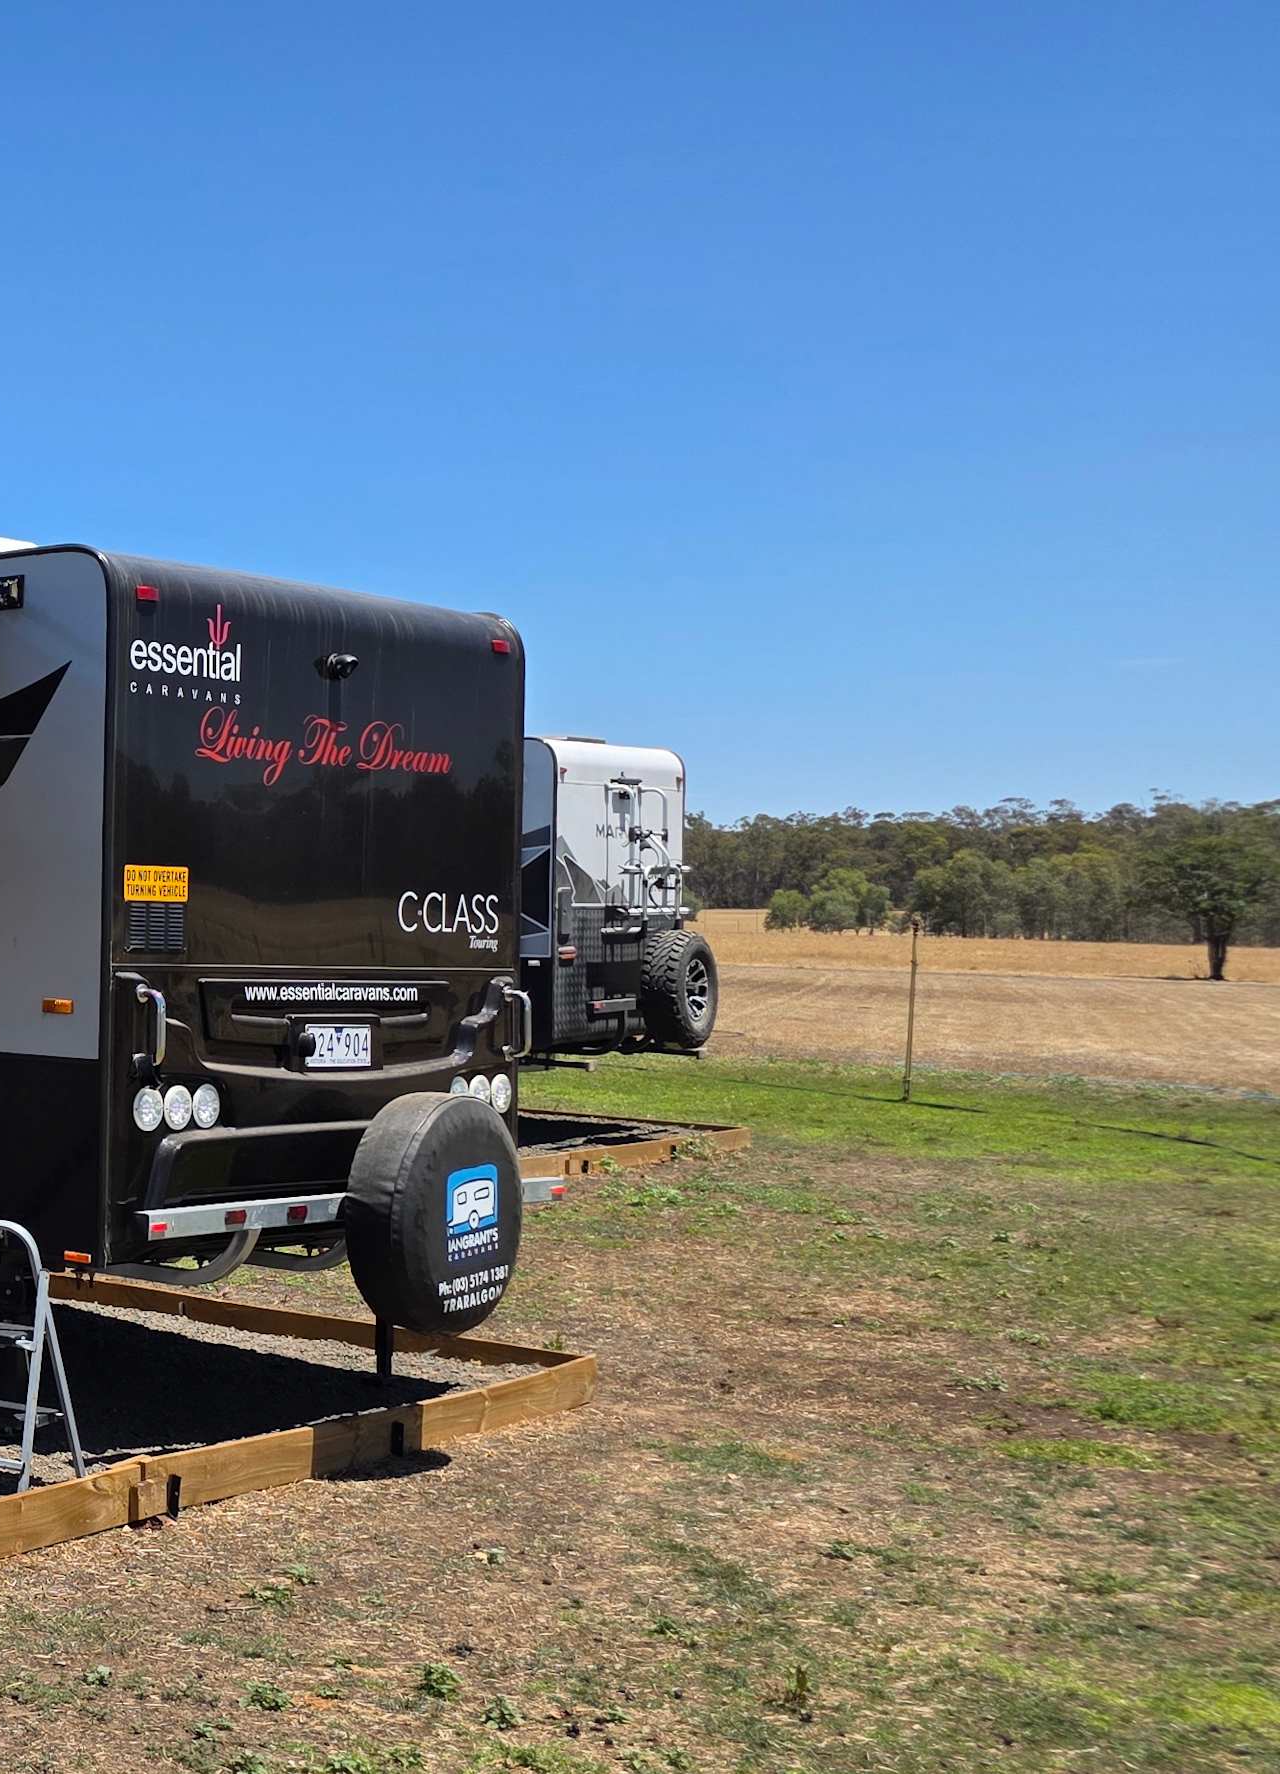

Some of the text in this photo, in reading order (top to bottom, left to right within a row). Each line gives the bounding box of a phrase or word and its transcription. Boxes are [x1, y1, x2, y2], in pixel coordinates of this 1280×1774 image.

[130, 639, 241, 681] essential
[130, 681, 241, 705] CARAVANS
[195, 706, 452, 786] Living The Dream
[127, 869, 186, 882] DO NOT OVERTAKE
[127, 884, 186, 897] TURNING VEHICLE
[469, 935, 498, 953] Touring
[244, 982, 418, 1002] www.essentialcaravans.com
[452, 1275, 469, 1296] (03)
[469, 1270, 489, 1288] 5174
[443, 1284, 503, 1313] TRARALGON
